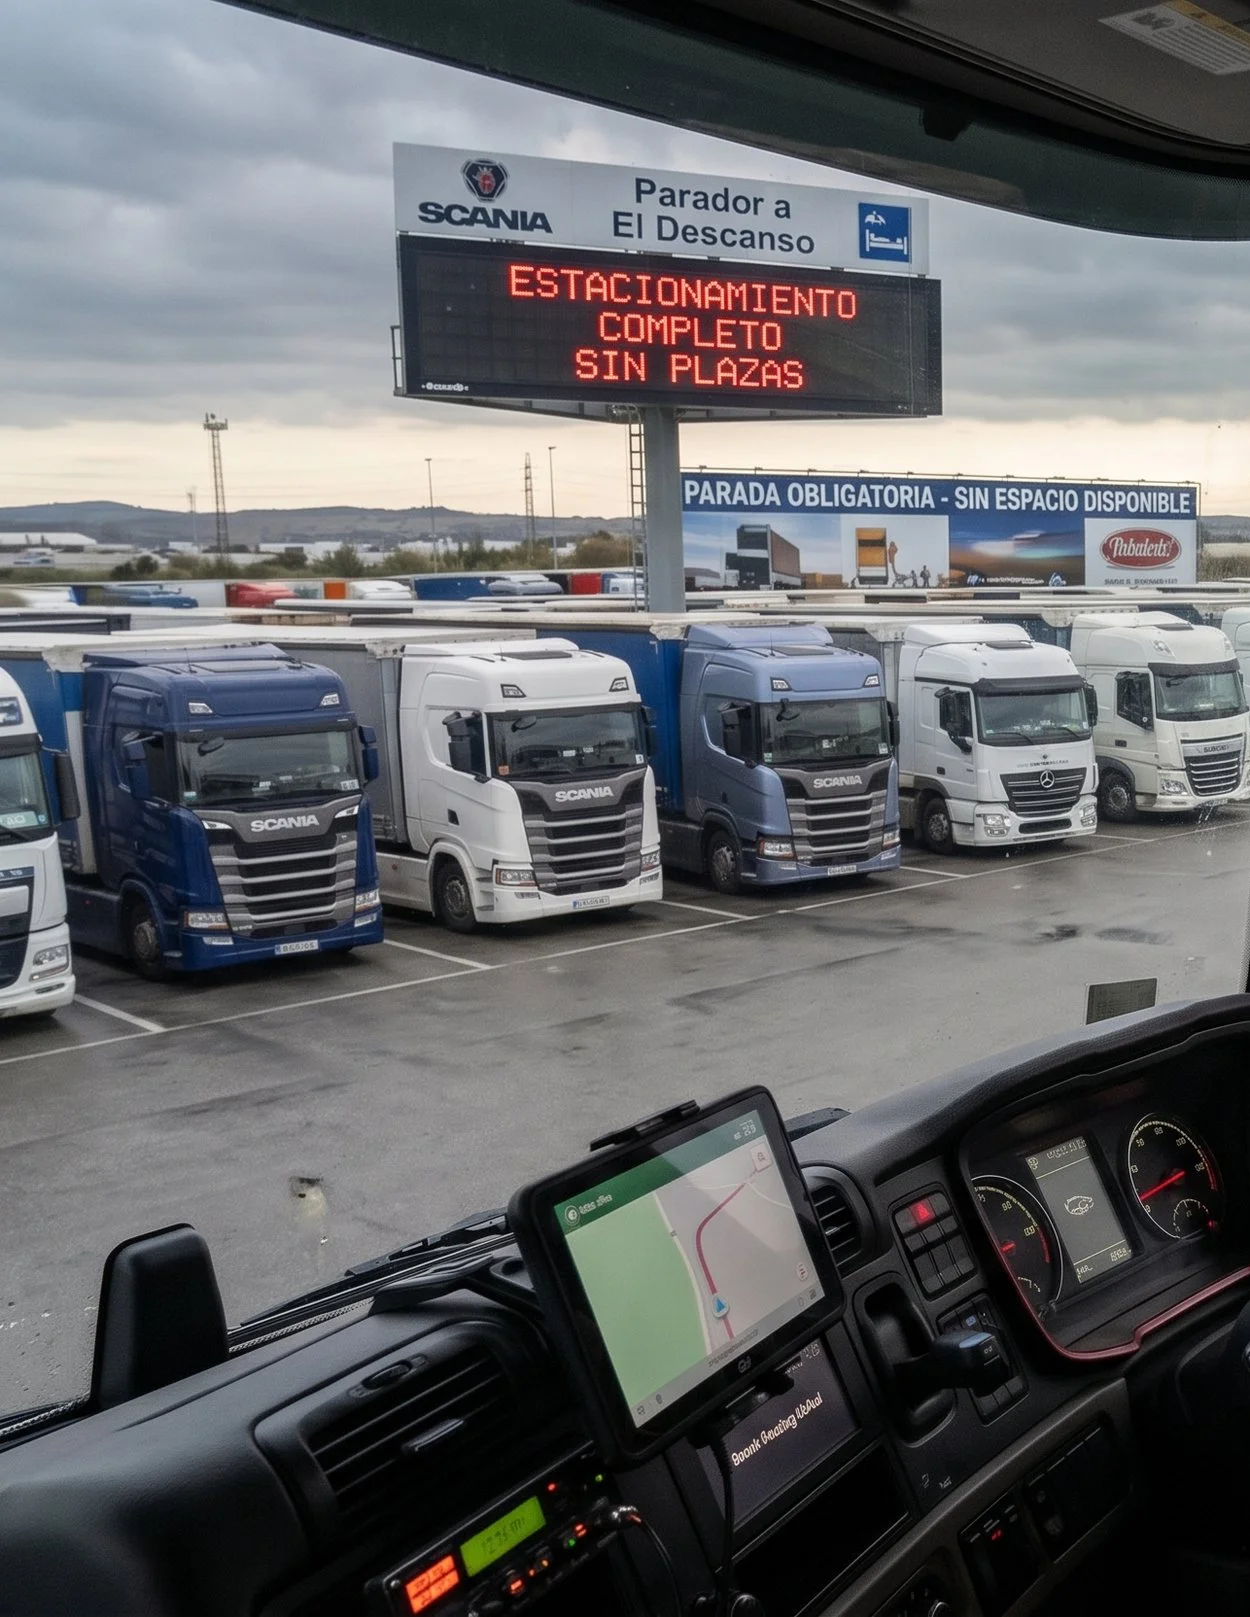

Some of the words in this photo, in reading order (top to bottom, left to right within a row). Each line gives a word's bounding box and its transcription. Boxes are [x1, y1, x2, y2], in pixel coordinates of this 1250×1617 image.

[634, 177, 764, 216] Parador
[774, 198, 791, 219] a
[418, 201, 553, 234] SCANIA
[612, 211, 643, 239] El
[656, 214, 815, 254] Descanso
[508, 264, 857, 320] ESTACIONAMIENTO
[598, 311, 782, 352] COMPLETO
[574, 348, 647, 382] SIN
[669, 353, 805, 390] PLAZAS
[684, 479, 781, 508] PARADA
[786, 482, 936, 510] OBLIGATORIA
[954, 486, 990, 510] SIN
[995, 487, 1079, 512] ESPACIO
[1084, 489, 1191, 514] DISPONIBLE
[555, 786, 615, 803] SCANIA
[813, 775, 863, 789] SCANIA
[250, 814, 320, 833] SCANIA
